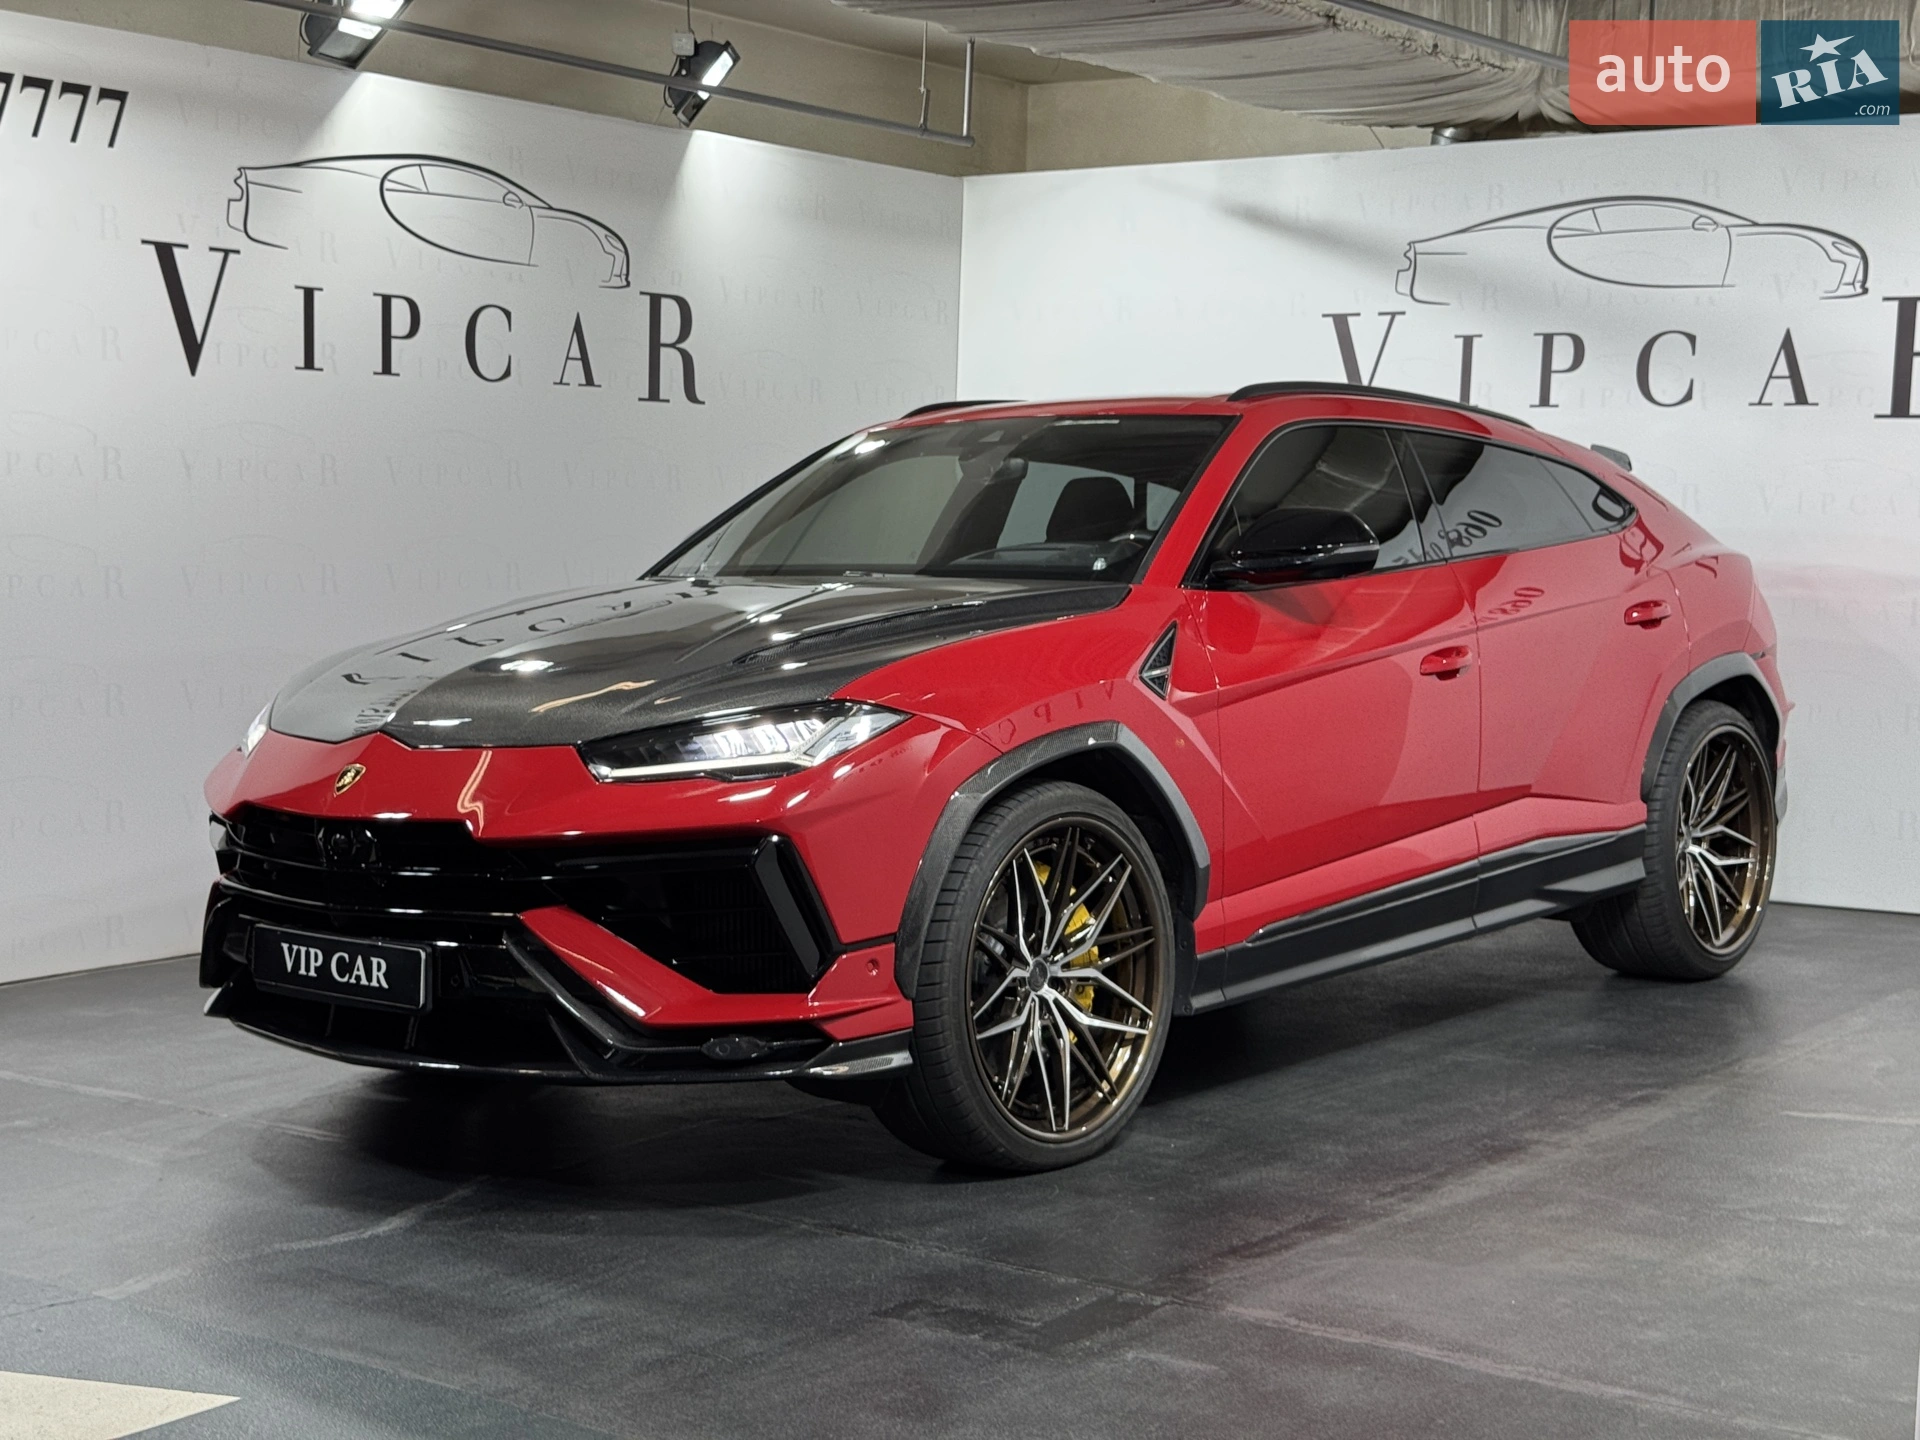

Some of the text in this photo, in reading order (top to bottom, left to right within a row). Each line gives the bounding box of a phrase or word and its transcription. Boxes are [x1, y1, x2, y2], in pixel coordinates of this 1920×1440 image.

[141, 239, 706, 406] VIPCAR
[280, 942, 389, 989] VIP CAR
